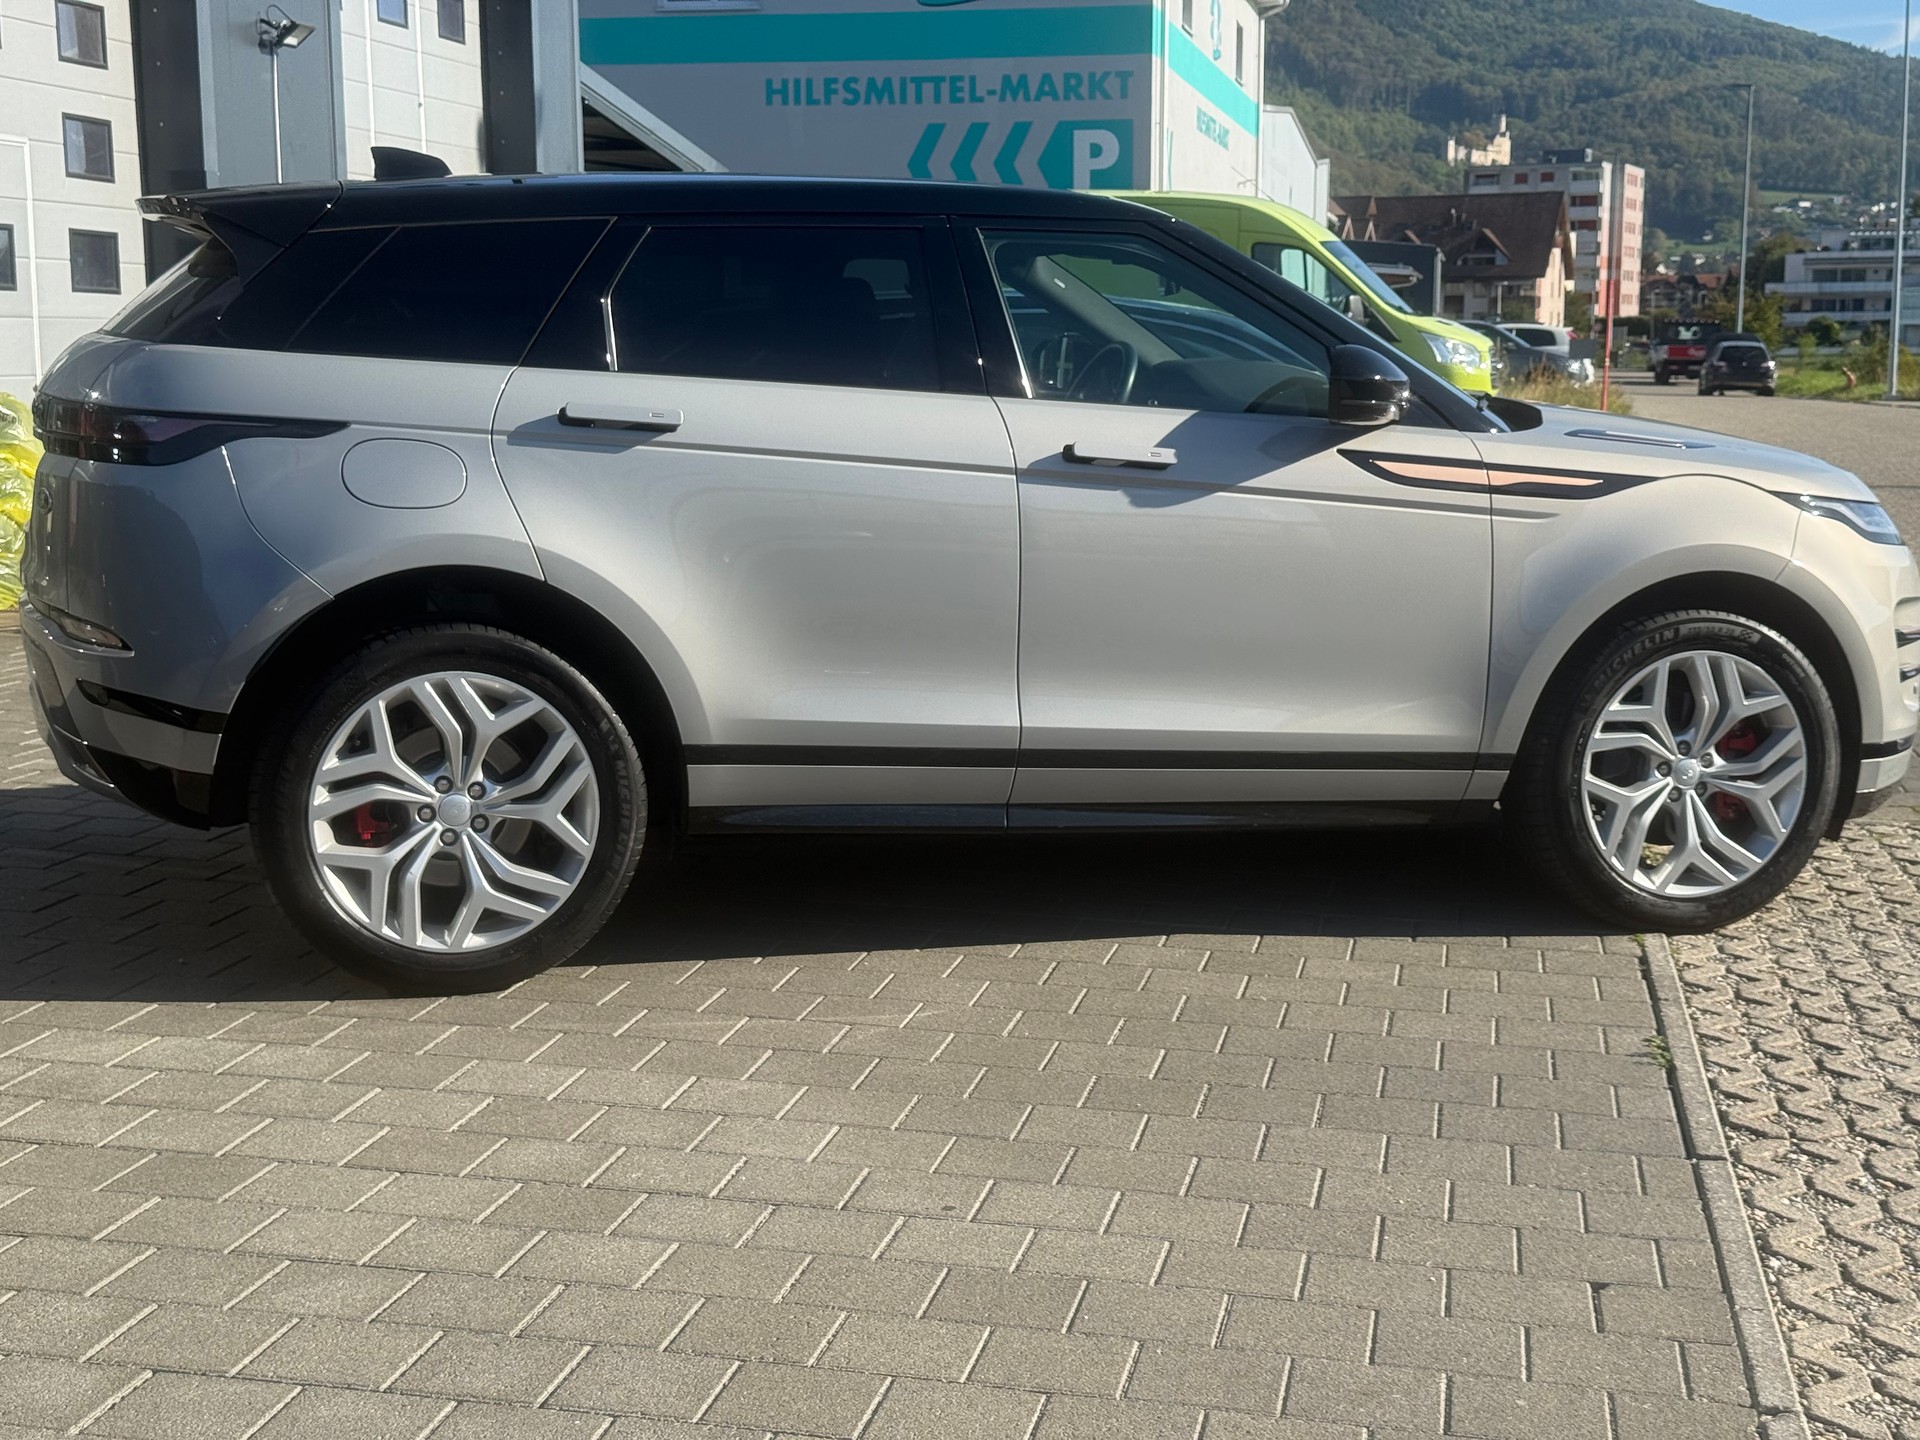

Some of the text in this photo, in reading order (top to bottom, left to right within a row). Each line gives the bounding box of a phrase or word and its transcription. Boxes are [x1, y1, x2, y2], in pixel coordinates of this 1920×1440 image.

[765, 70, 1134, 106] HILFSMITTEL-MARKT
[1073, 129, 1121, 189] P
[1593, 628, 1676, 690] MICHELIN
